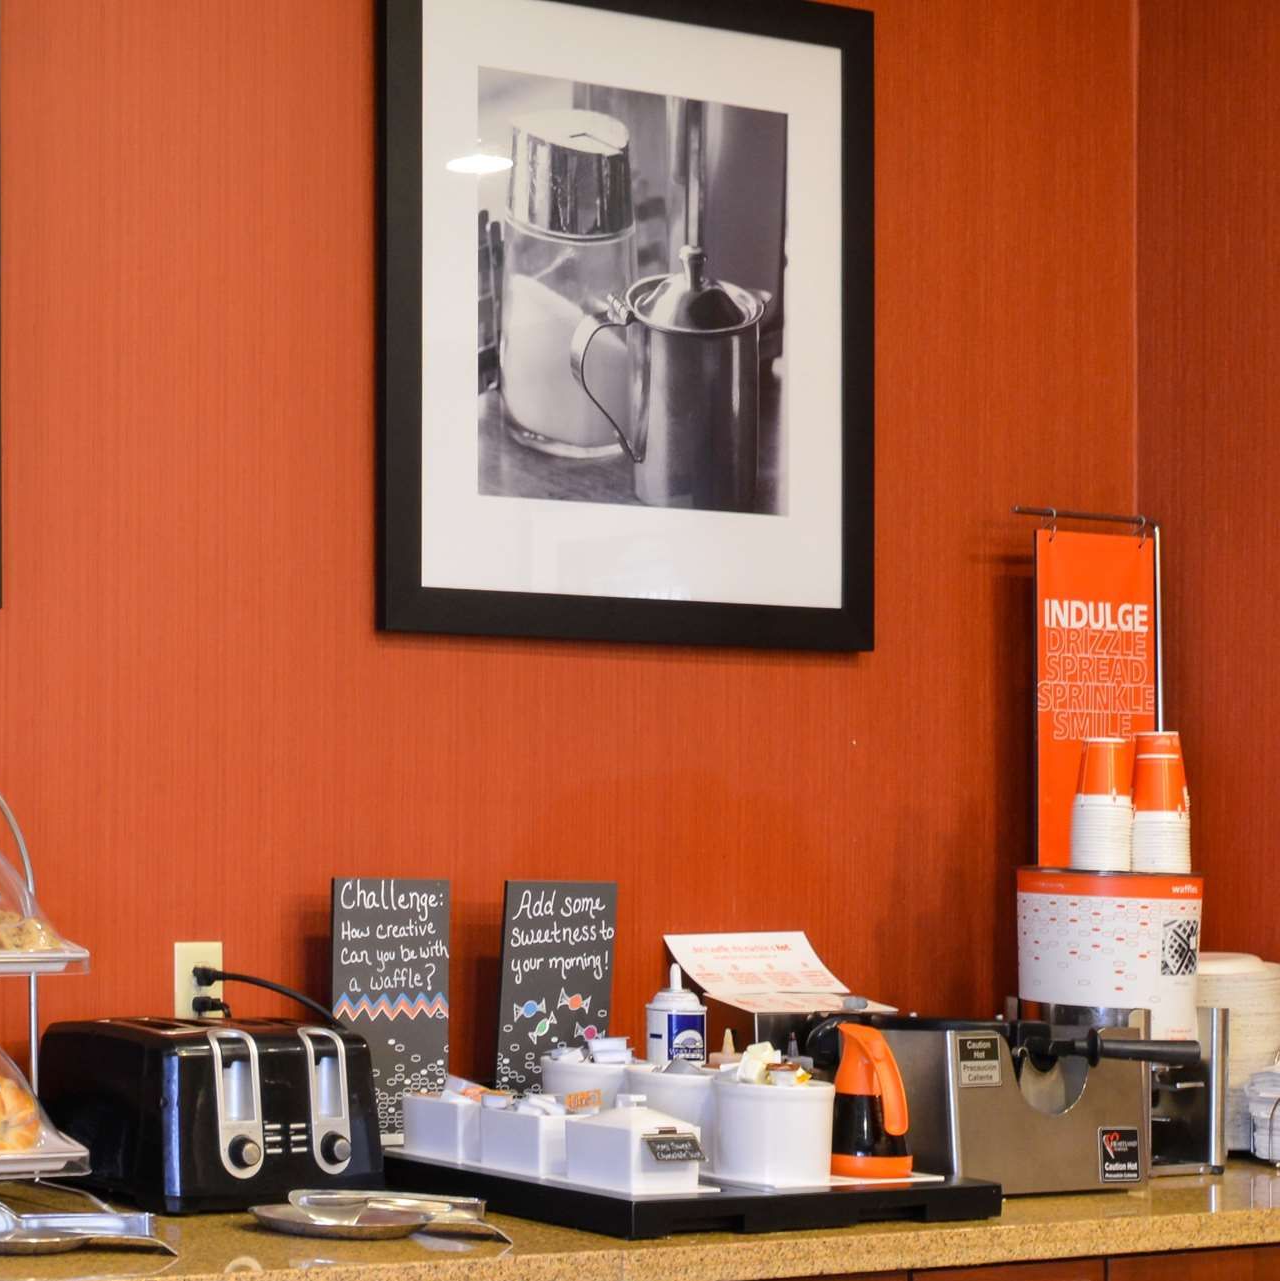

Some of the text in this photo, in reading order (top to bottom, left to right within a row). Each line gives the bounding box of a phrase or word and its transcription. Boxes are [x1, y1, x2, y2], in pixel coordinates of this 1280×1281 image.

[1044, 599, 1148, 632] INDULGE
[1046, 627, 1147, 659] DRIZZLE
[1045, 654, 1147, 686] SPREAD
[1038, 681, 1154, 714] SPRINKLE
[341, 879, 444, 921] Challenge:
[512, 889, 606, 920] Add some
[341, 918, 436, 941] How creative
[511, 920, 615, 947] sweetness to
[377, 949, 395, 972] you
[400, 944, 418, 962] be
[420, 939, 449, 959] with
[511, 950, 609, 985] your morning!
[349, 963, 436, 992] a waffle?
[967, 1040, 991, 1049] Caution
[973, 1051, 985, 1059] Hot
[1105, 1162, 1138, 1171] Caution Hot
